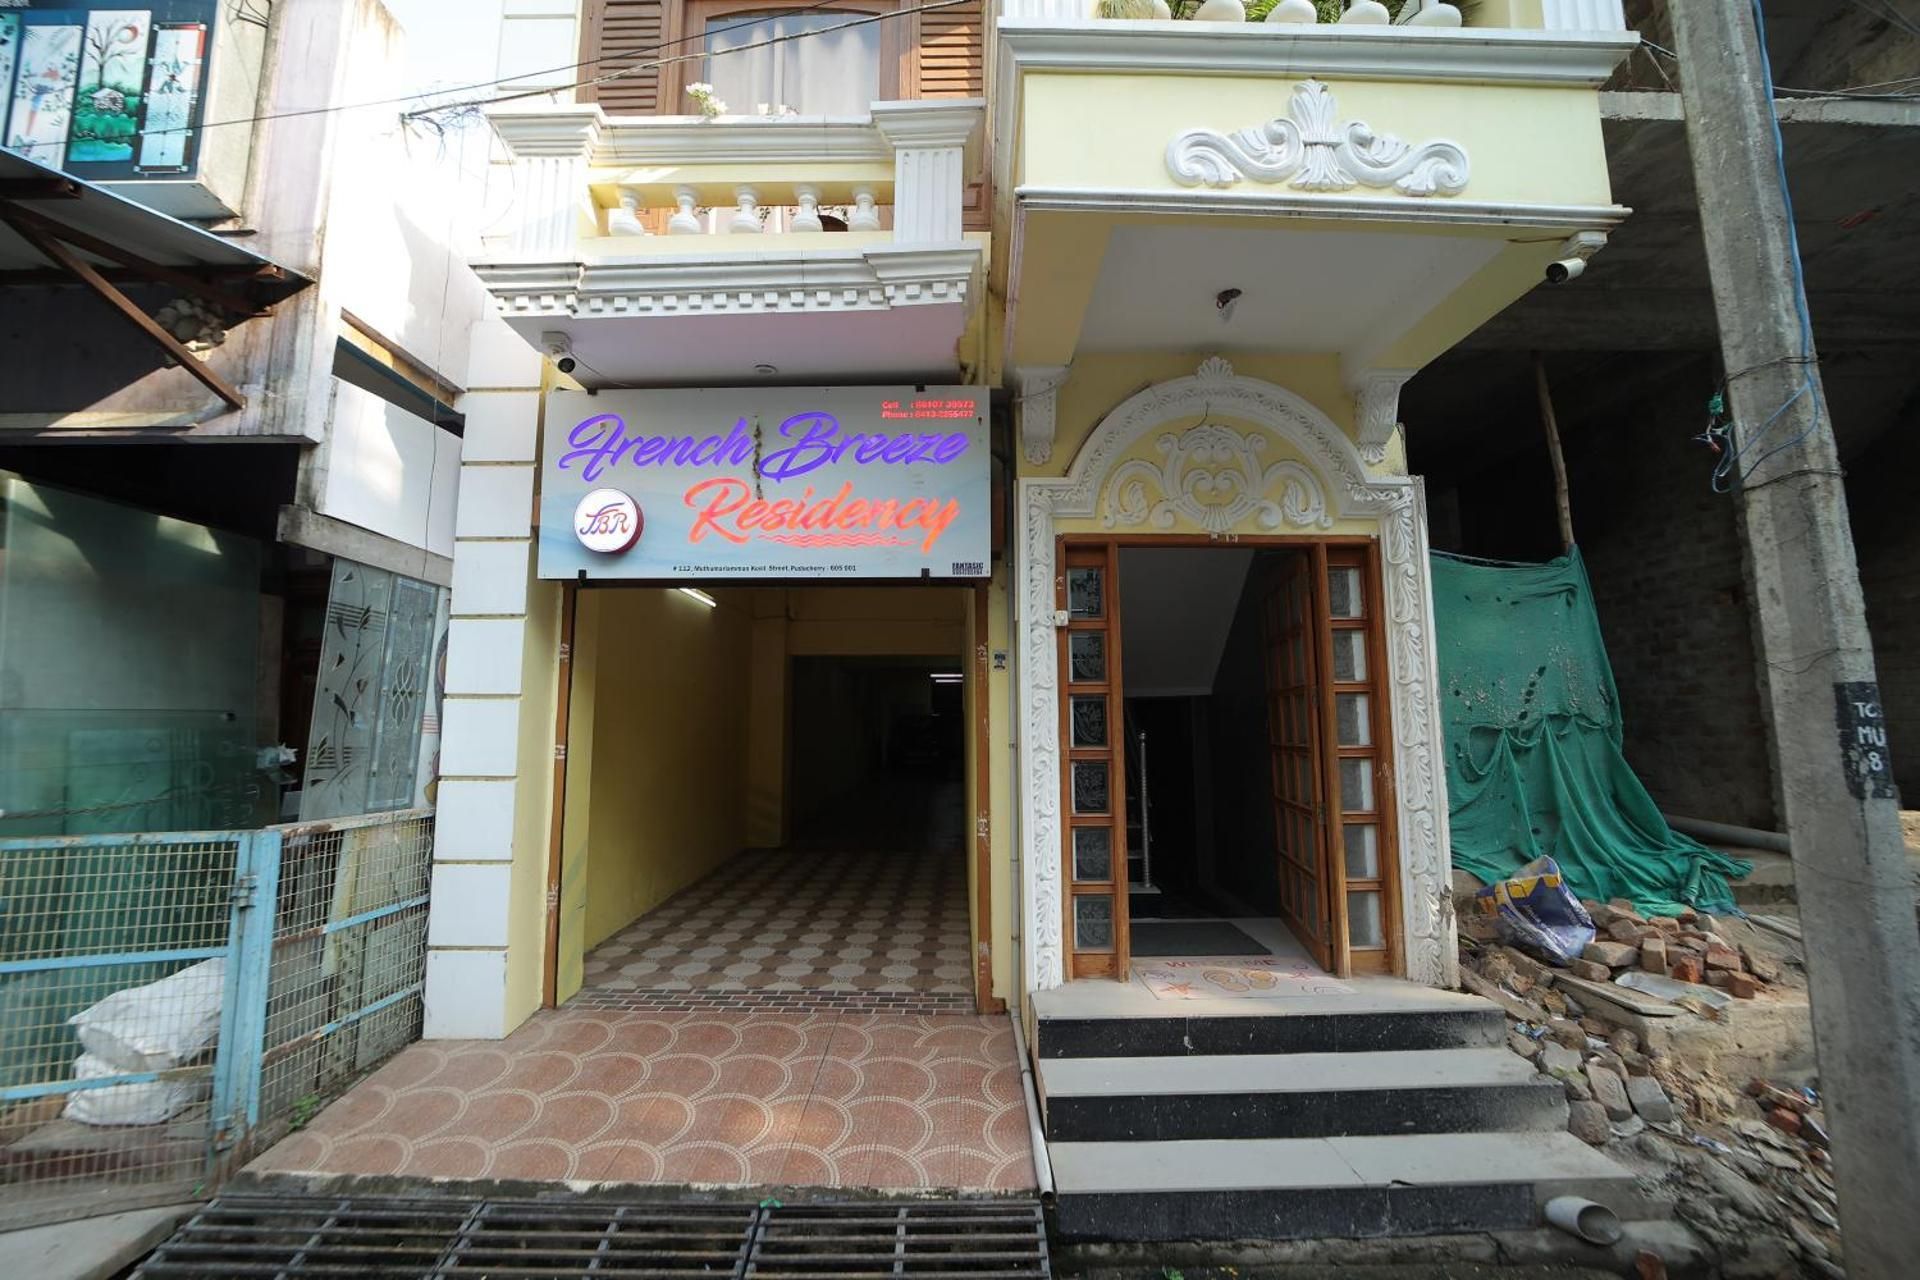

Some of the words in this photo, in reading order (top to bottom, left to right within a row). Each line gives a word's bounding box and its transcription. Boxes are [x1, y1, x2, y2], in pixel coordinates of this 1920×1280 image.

[558, 413, 754, 482] French
[758, 411, 970, 483] Breeze
[683, 477, 958, 554] Residency
